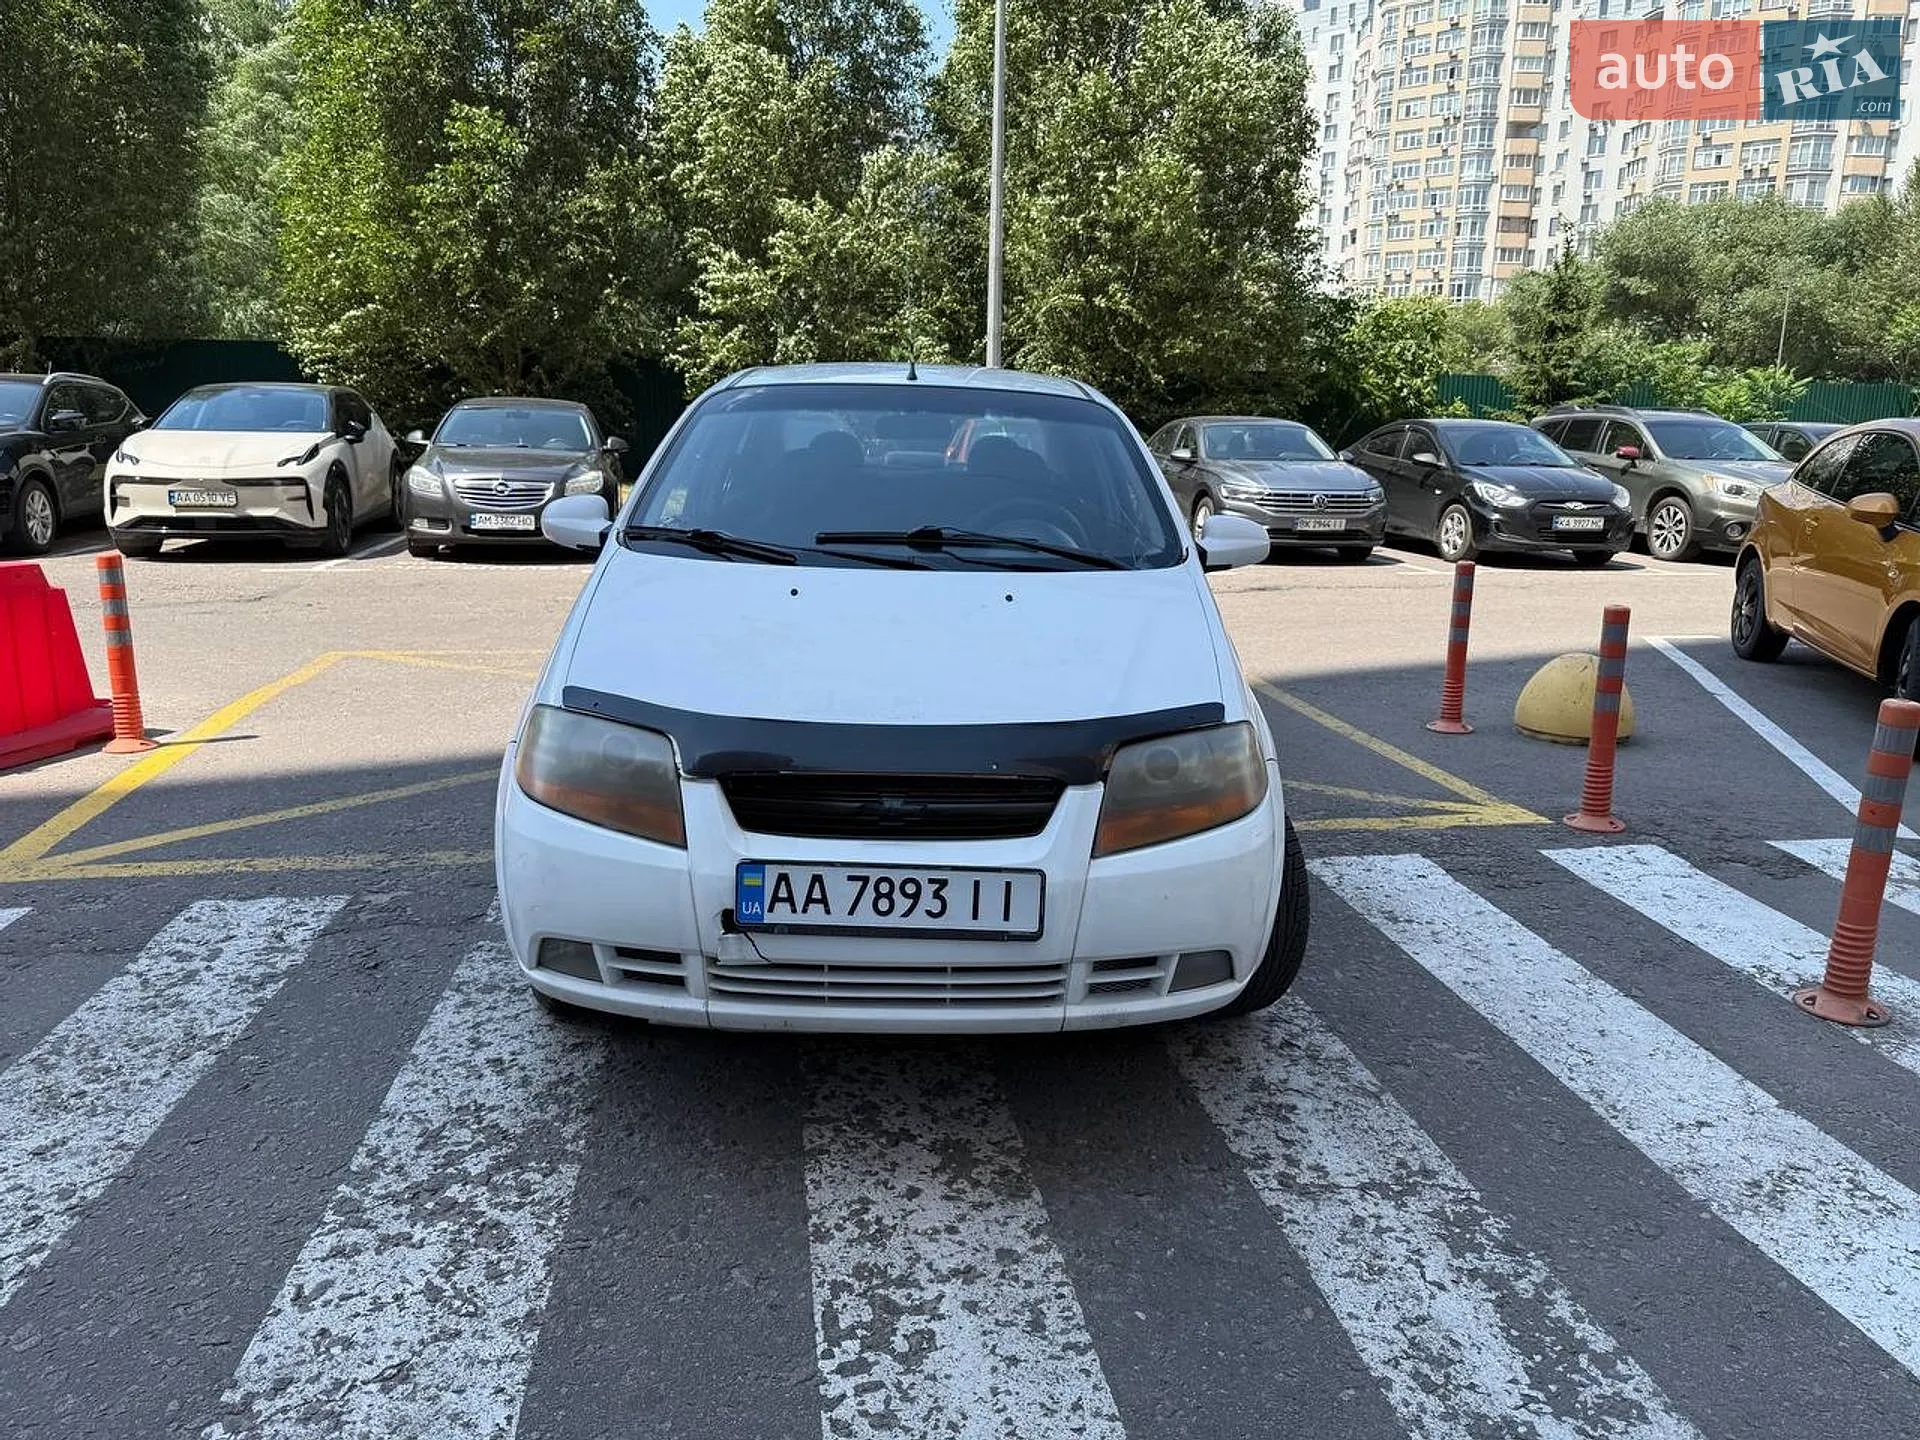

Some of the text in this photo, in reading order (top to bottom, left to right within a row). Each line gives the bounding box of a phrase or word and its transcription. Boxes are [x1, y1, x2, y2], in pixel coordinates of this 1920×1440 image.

[741, 901, 762, 915] UA
[766, 872, 832, 916] AA
[846, 874, 950, 919] 7893
